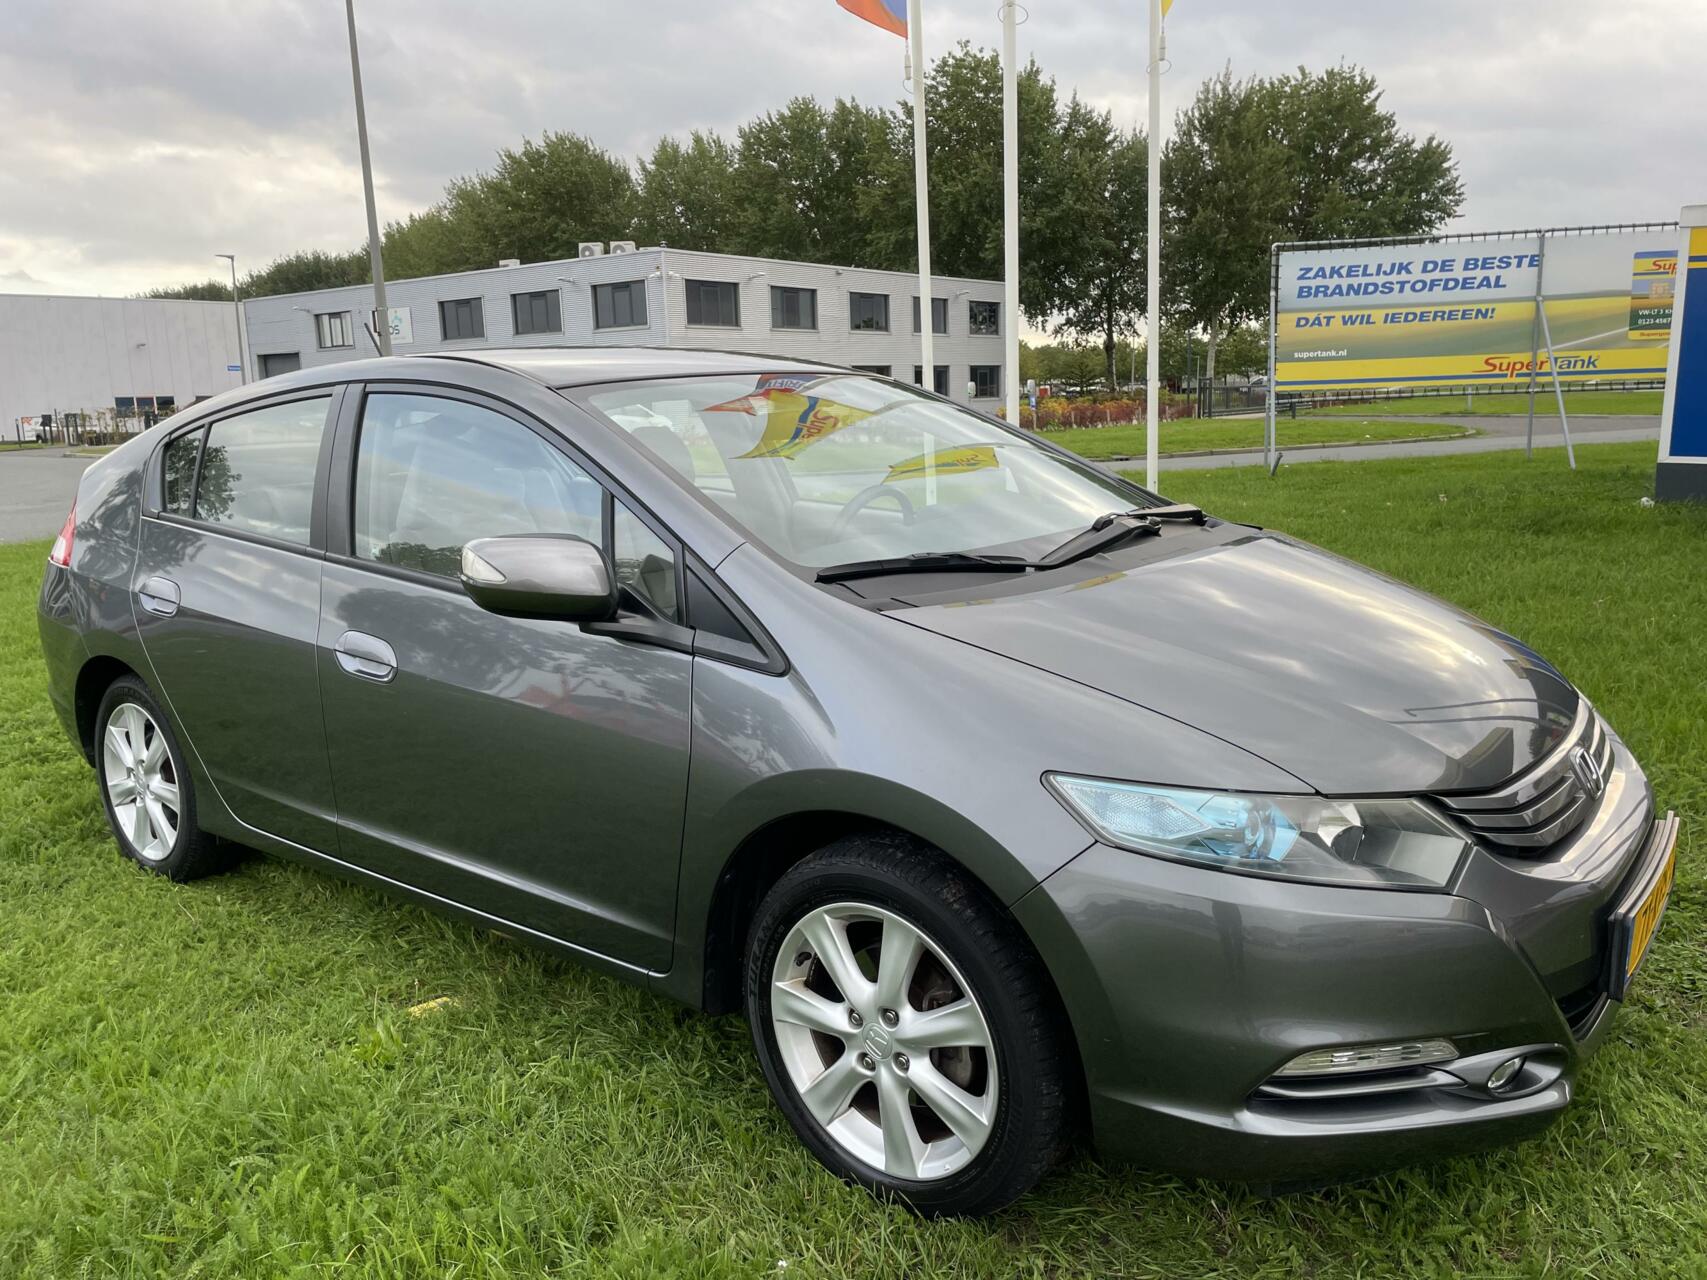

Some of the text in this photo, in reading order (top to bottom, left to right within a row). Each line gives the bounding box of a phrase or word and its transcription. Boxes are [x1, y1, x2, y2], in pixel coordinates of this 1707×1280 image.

[1296, 254, 1541, 280] ZAKELIJK DE BESTE
[1296, 275, 1507, 298] BRANDSTOFDEAL
[1295, 307, 1496, 328] DÁT WIL IEDEREEN!
[1294, 349, 1347, 360] supertank.nl
